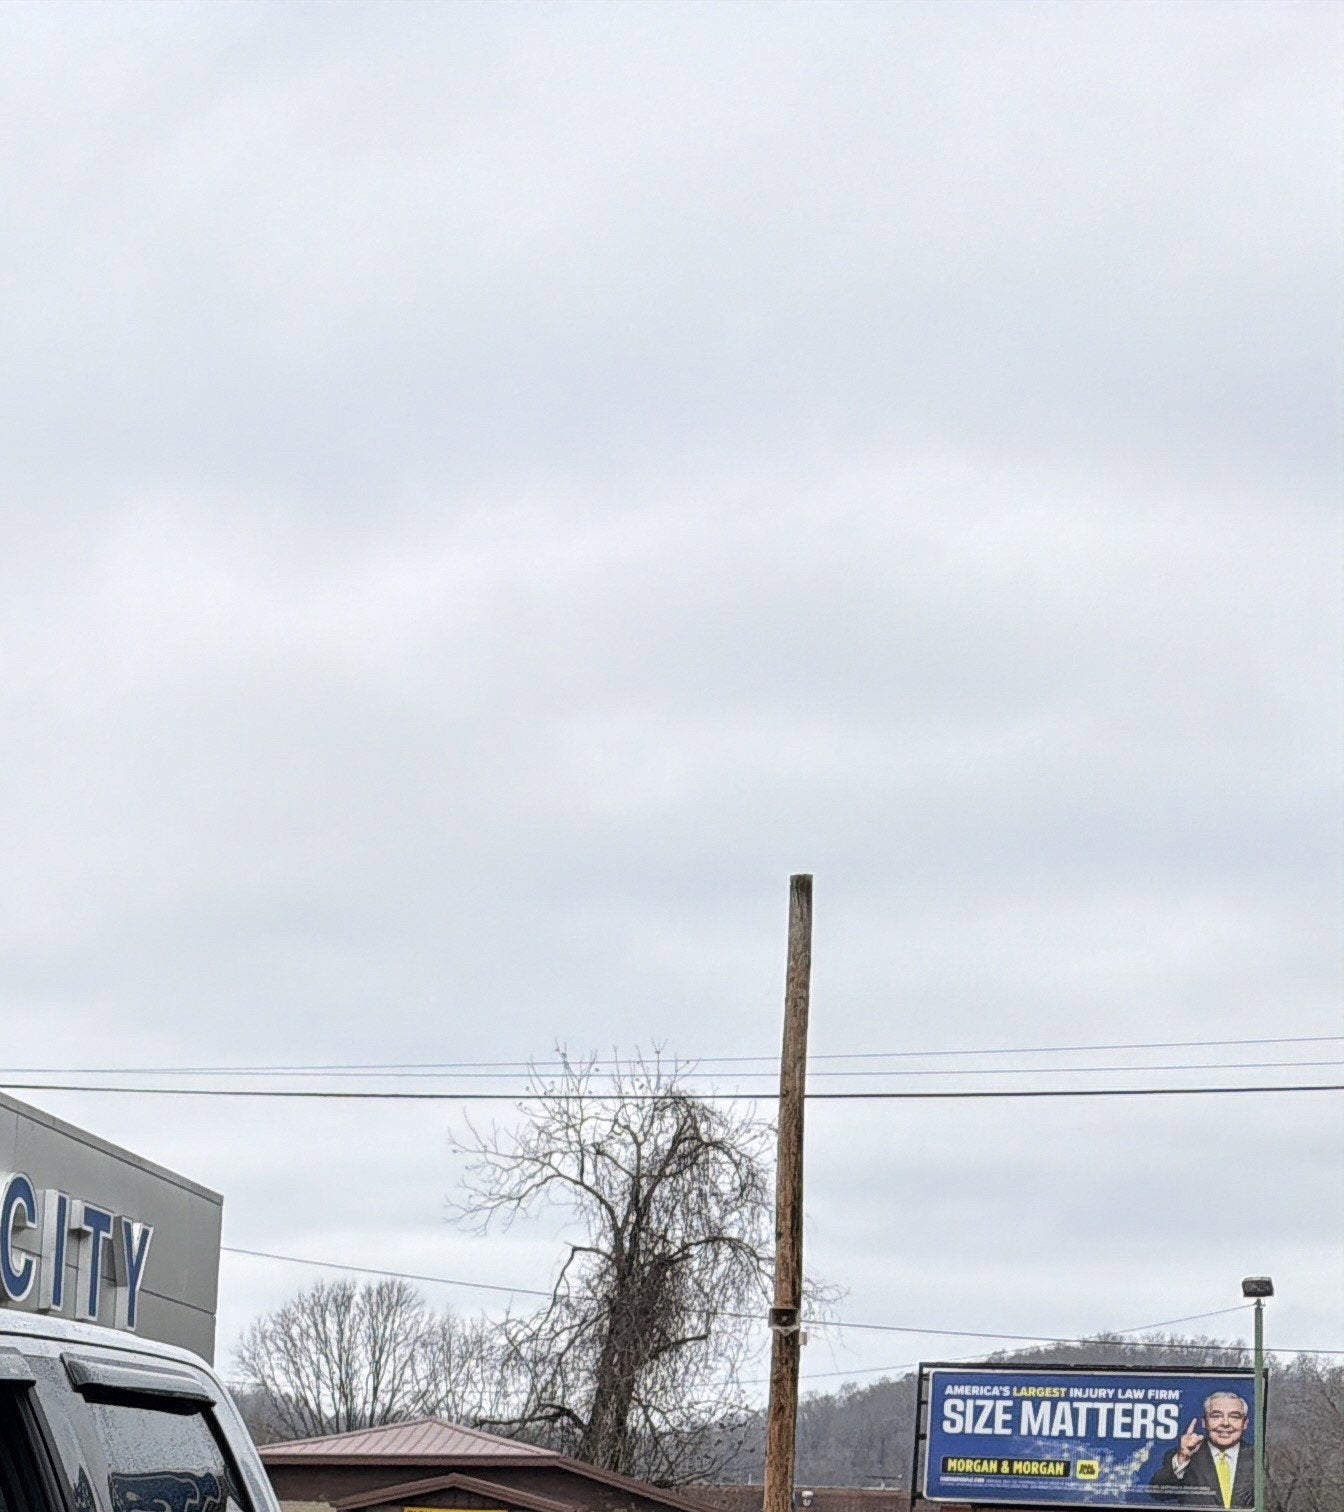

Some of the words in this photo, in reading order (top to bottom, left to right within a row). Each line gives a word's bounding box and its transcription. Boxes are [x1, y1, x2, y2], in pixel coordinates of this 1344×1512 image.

[944, 1384, 1011, 1397] AMERICA'S
[1012, 1386, 1067, 1398] LARGEST
[1069, 1387, 1116, 1400] INJURY
[1117, 1388, 1145, 1400] LAW
[1147, 1389, 1180, 1401] FIRM
[942, 1398, 1014, 1435] SIZE
[1019, 1400, 1180, 1440] MATTERS
[947, 1458, 998, 1473] MORGAN
[1000, 1460, 1010, 1474] &
[1013, 1460, 1065, 1476] MORGAN
